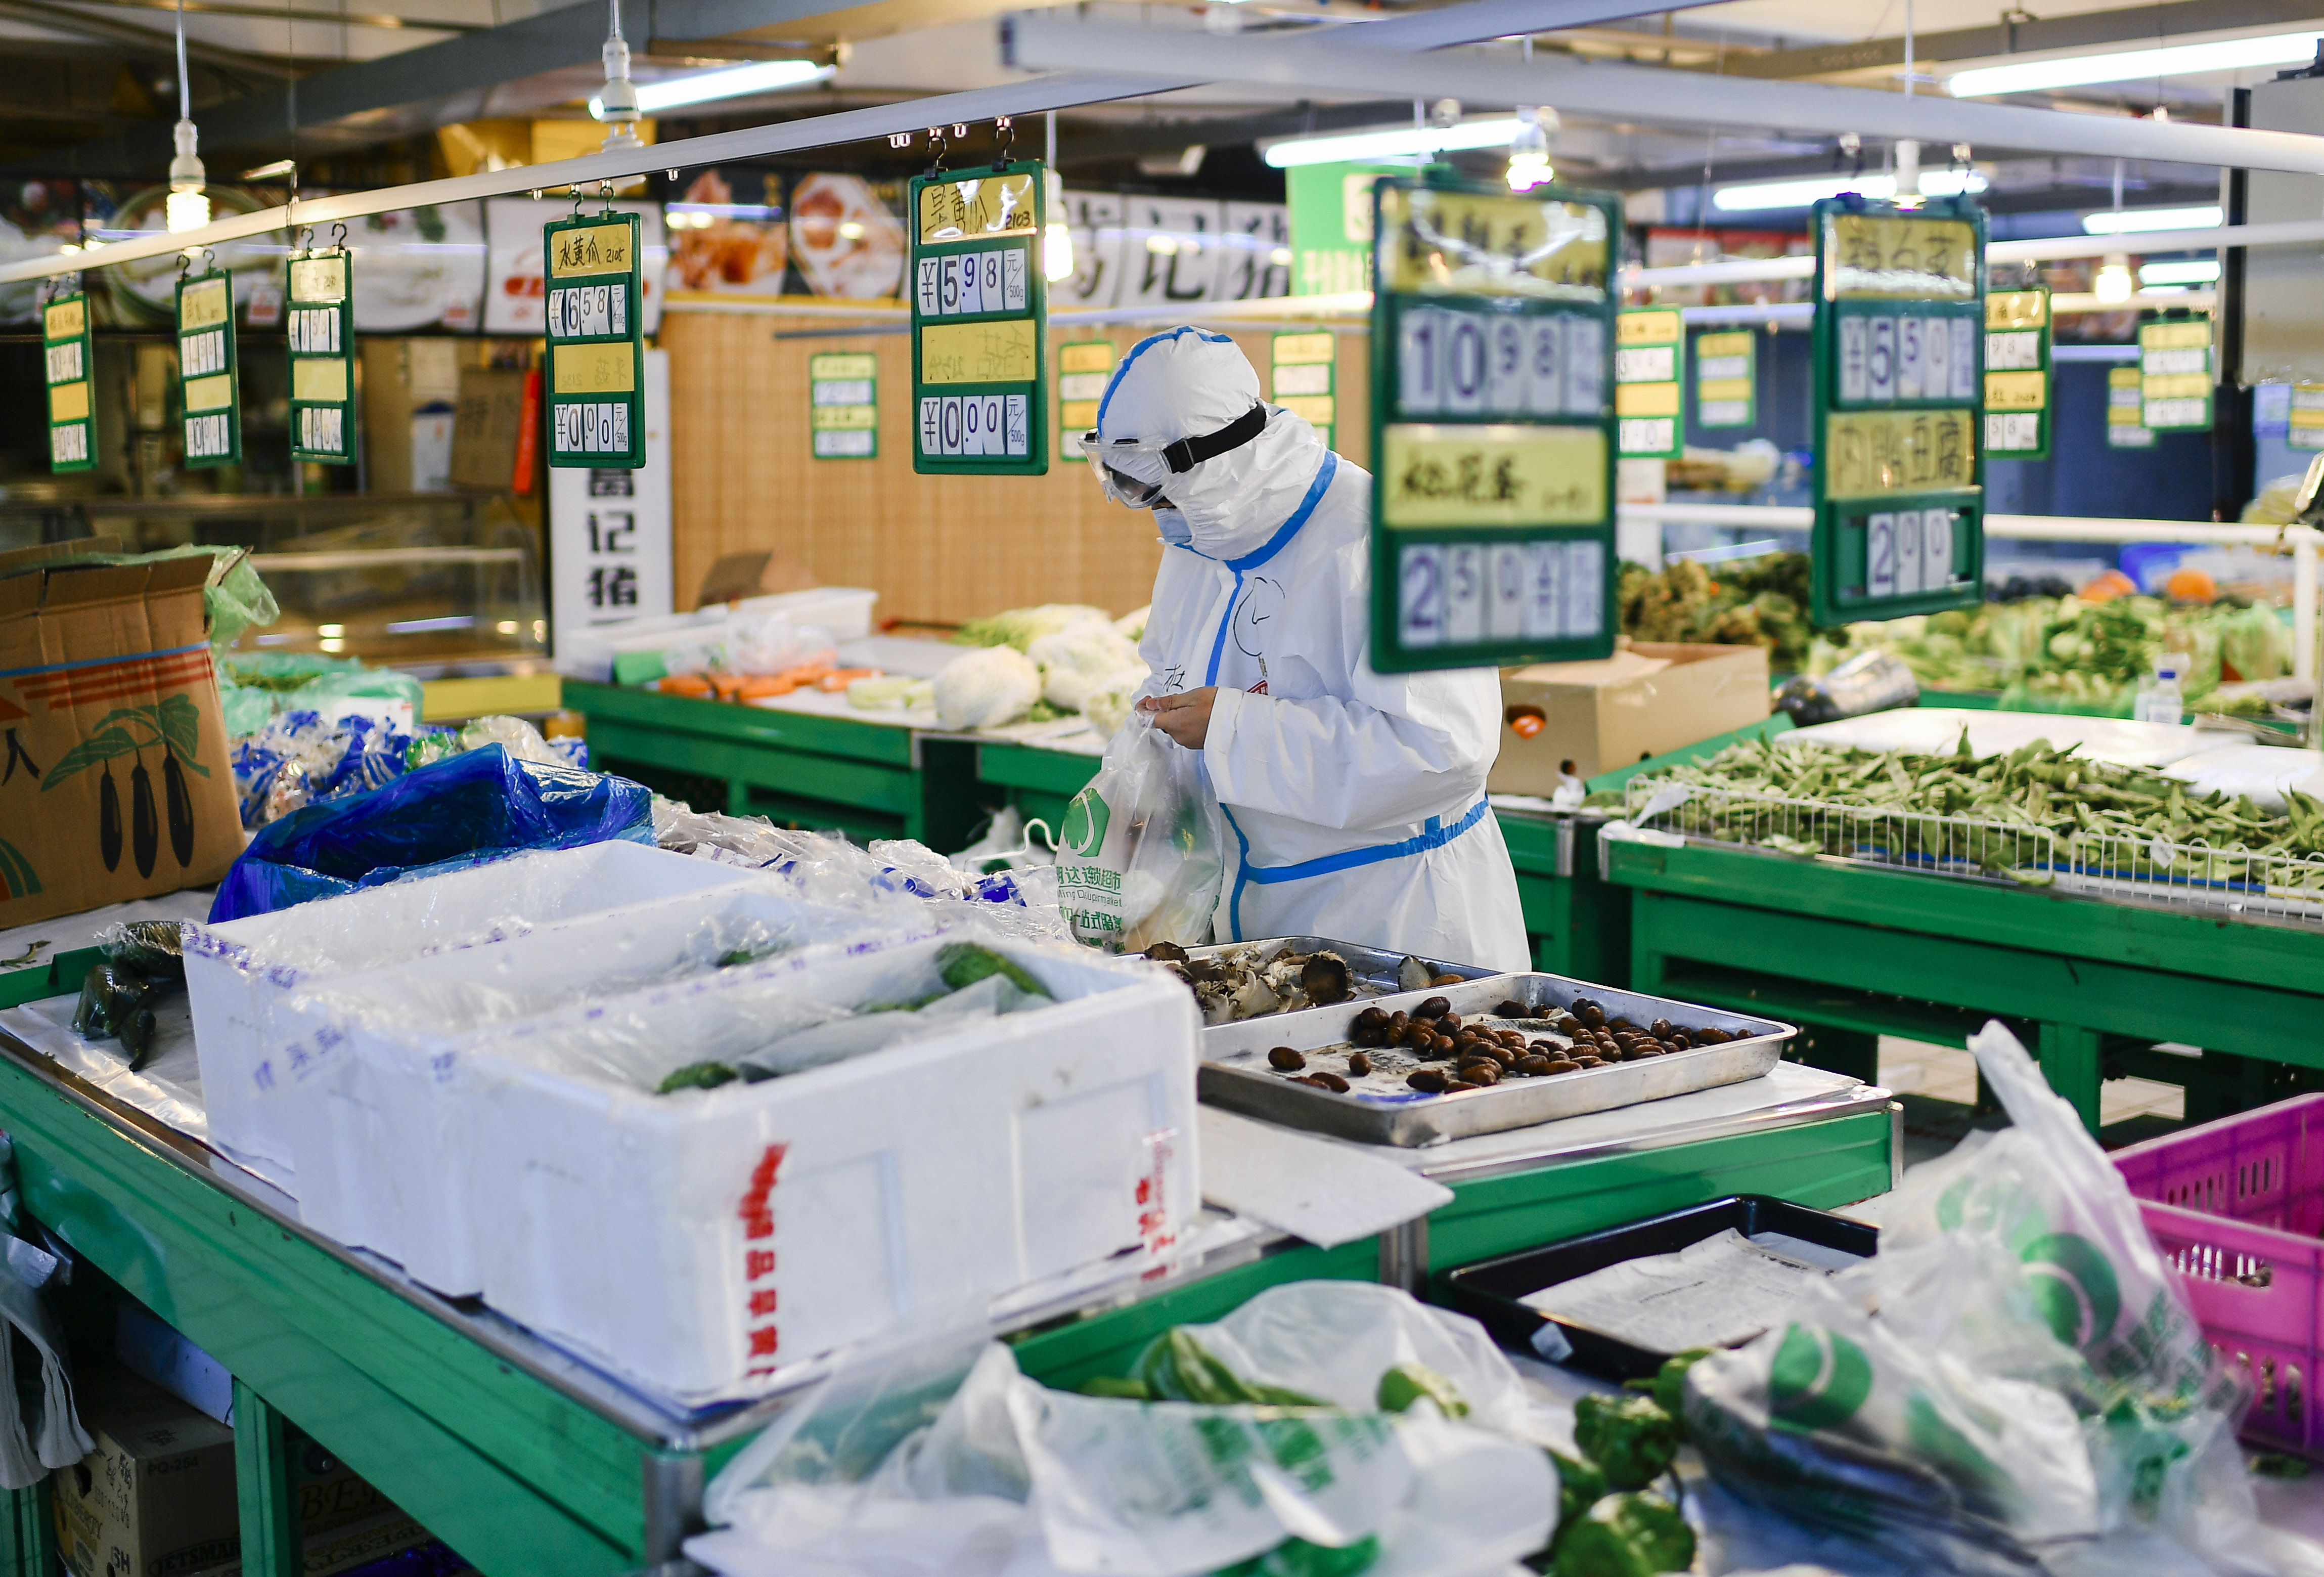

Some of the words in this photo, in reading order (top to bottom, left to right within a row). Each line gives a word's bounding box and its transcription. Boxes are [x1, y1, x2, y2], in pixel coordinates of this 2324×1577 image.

[1005, 211, 1031, 230] 2103
[559, 235, 601, 271] 水黄瓜
[606, 246, 625, 263] 2105
[922, 256, 997, 308] ¥5.98
[550, 289, 606, 330] ¥6.58
[556, 406, 610, 446] ¥0.00
[924, 401, 997, 448] ¥0.00
